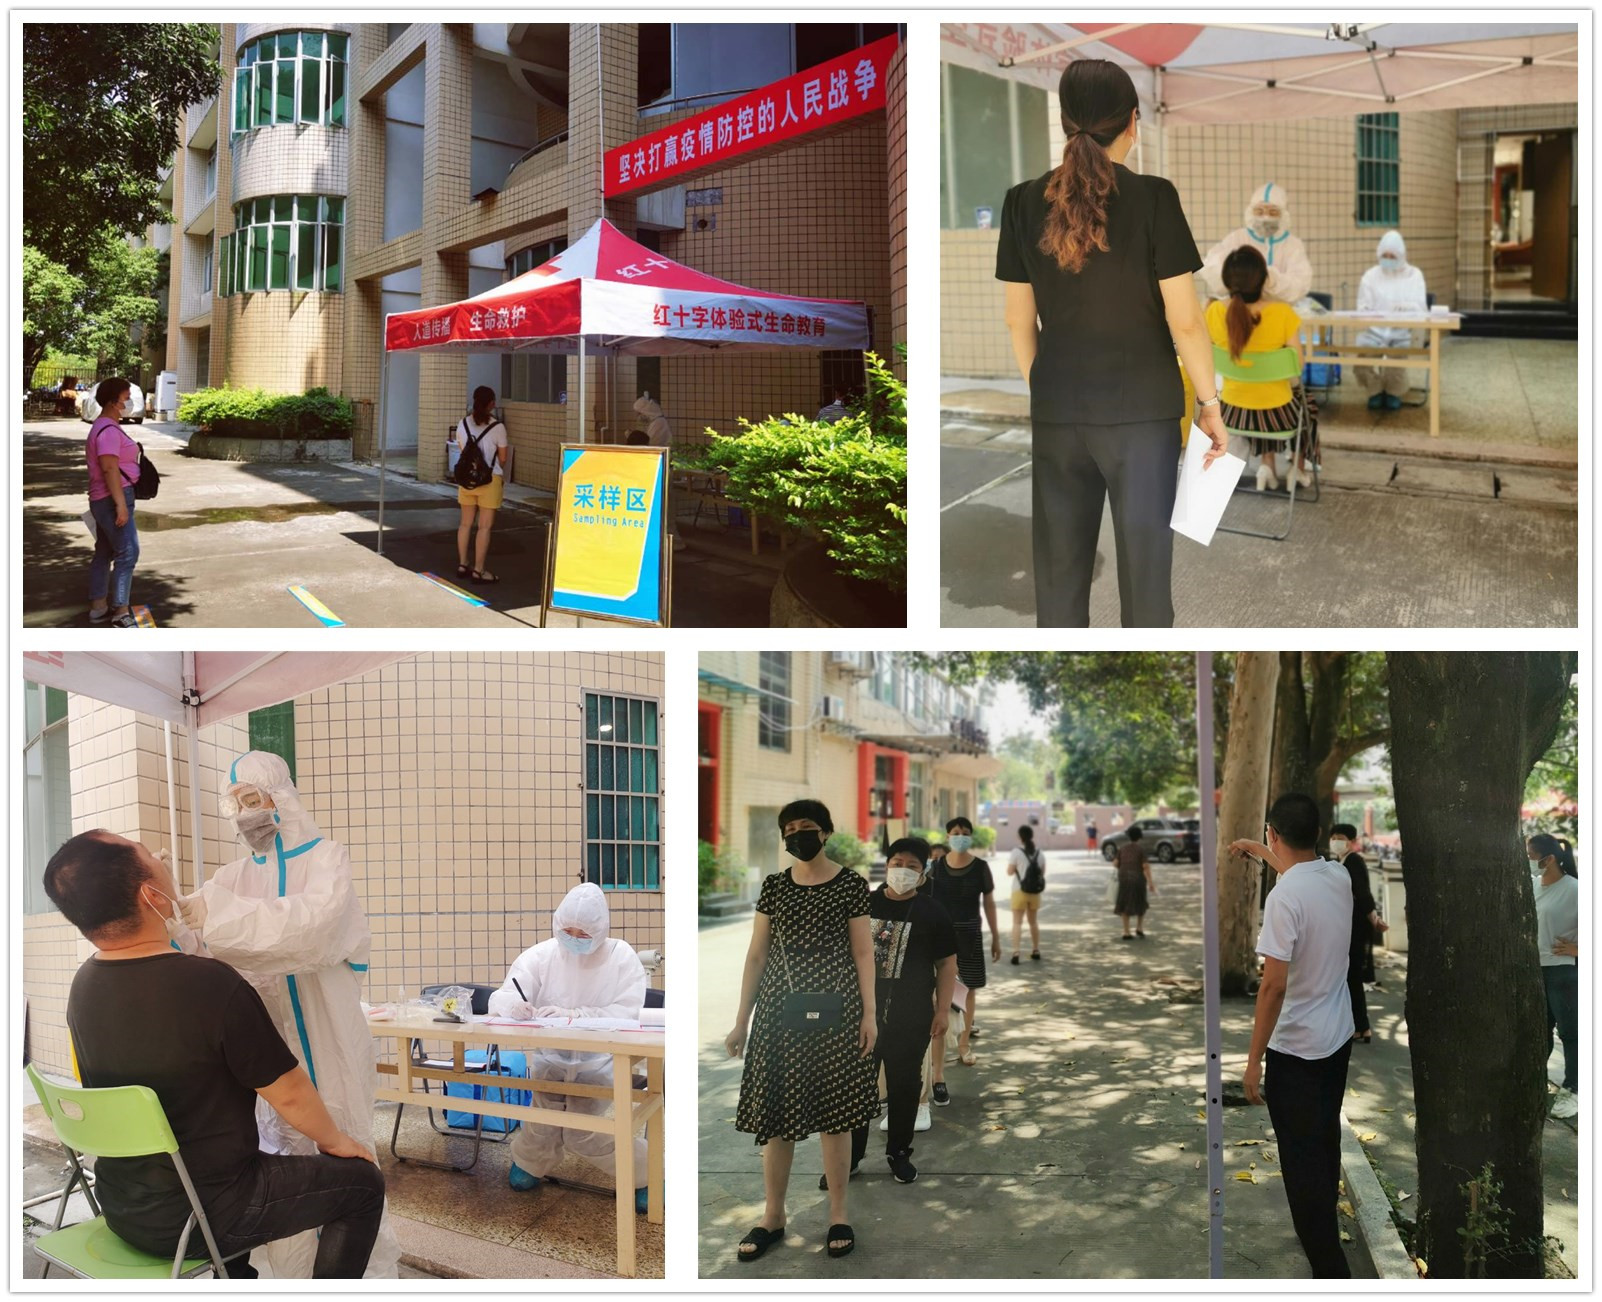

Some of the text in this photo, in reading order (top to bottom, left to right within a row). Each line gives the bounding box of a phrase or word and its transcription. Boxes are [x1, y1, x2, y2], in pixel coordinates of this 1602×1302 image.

[618, 58, 877, 184] 坚决打赢疫情防控的人民战争
[413, 305, 527, 342] 人道传播 生命救护
[653, 303, 826, 338] 红十字体验式生命教育
[573, 484, 647, 512] 采样区
[573, 513, 645, 528] Sampling Area
